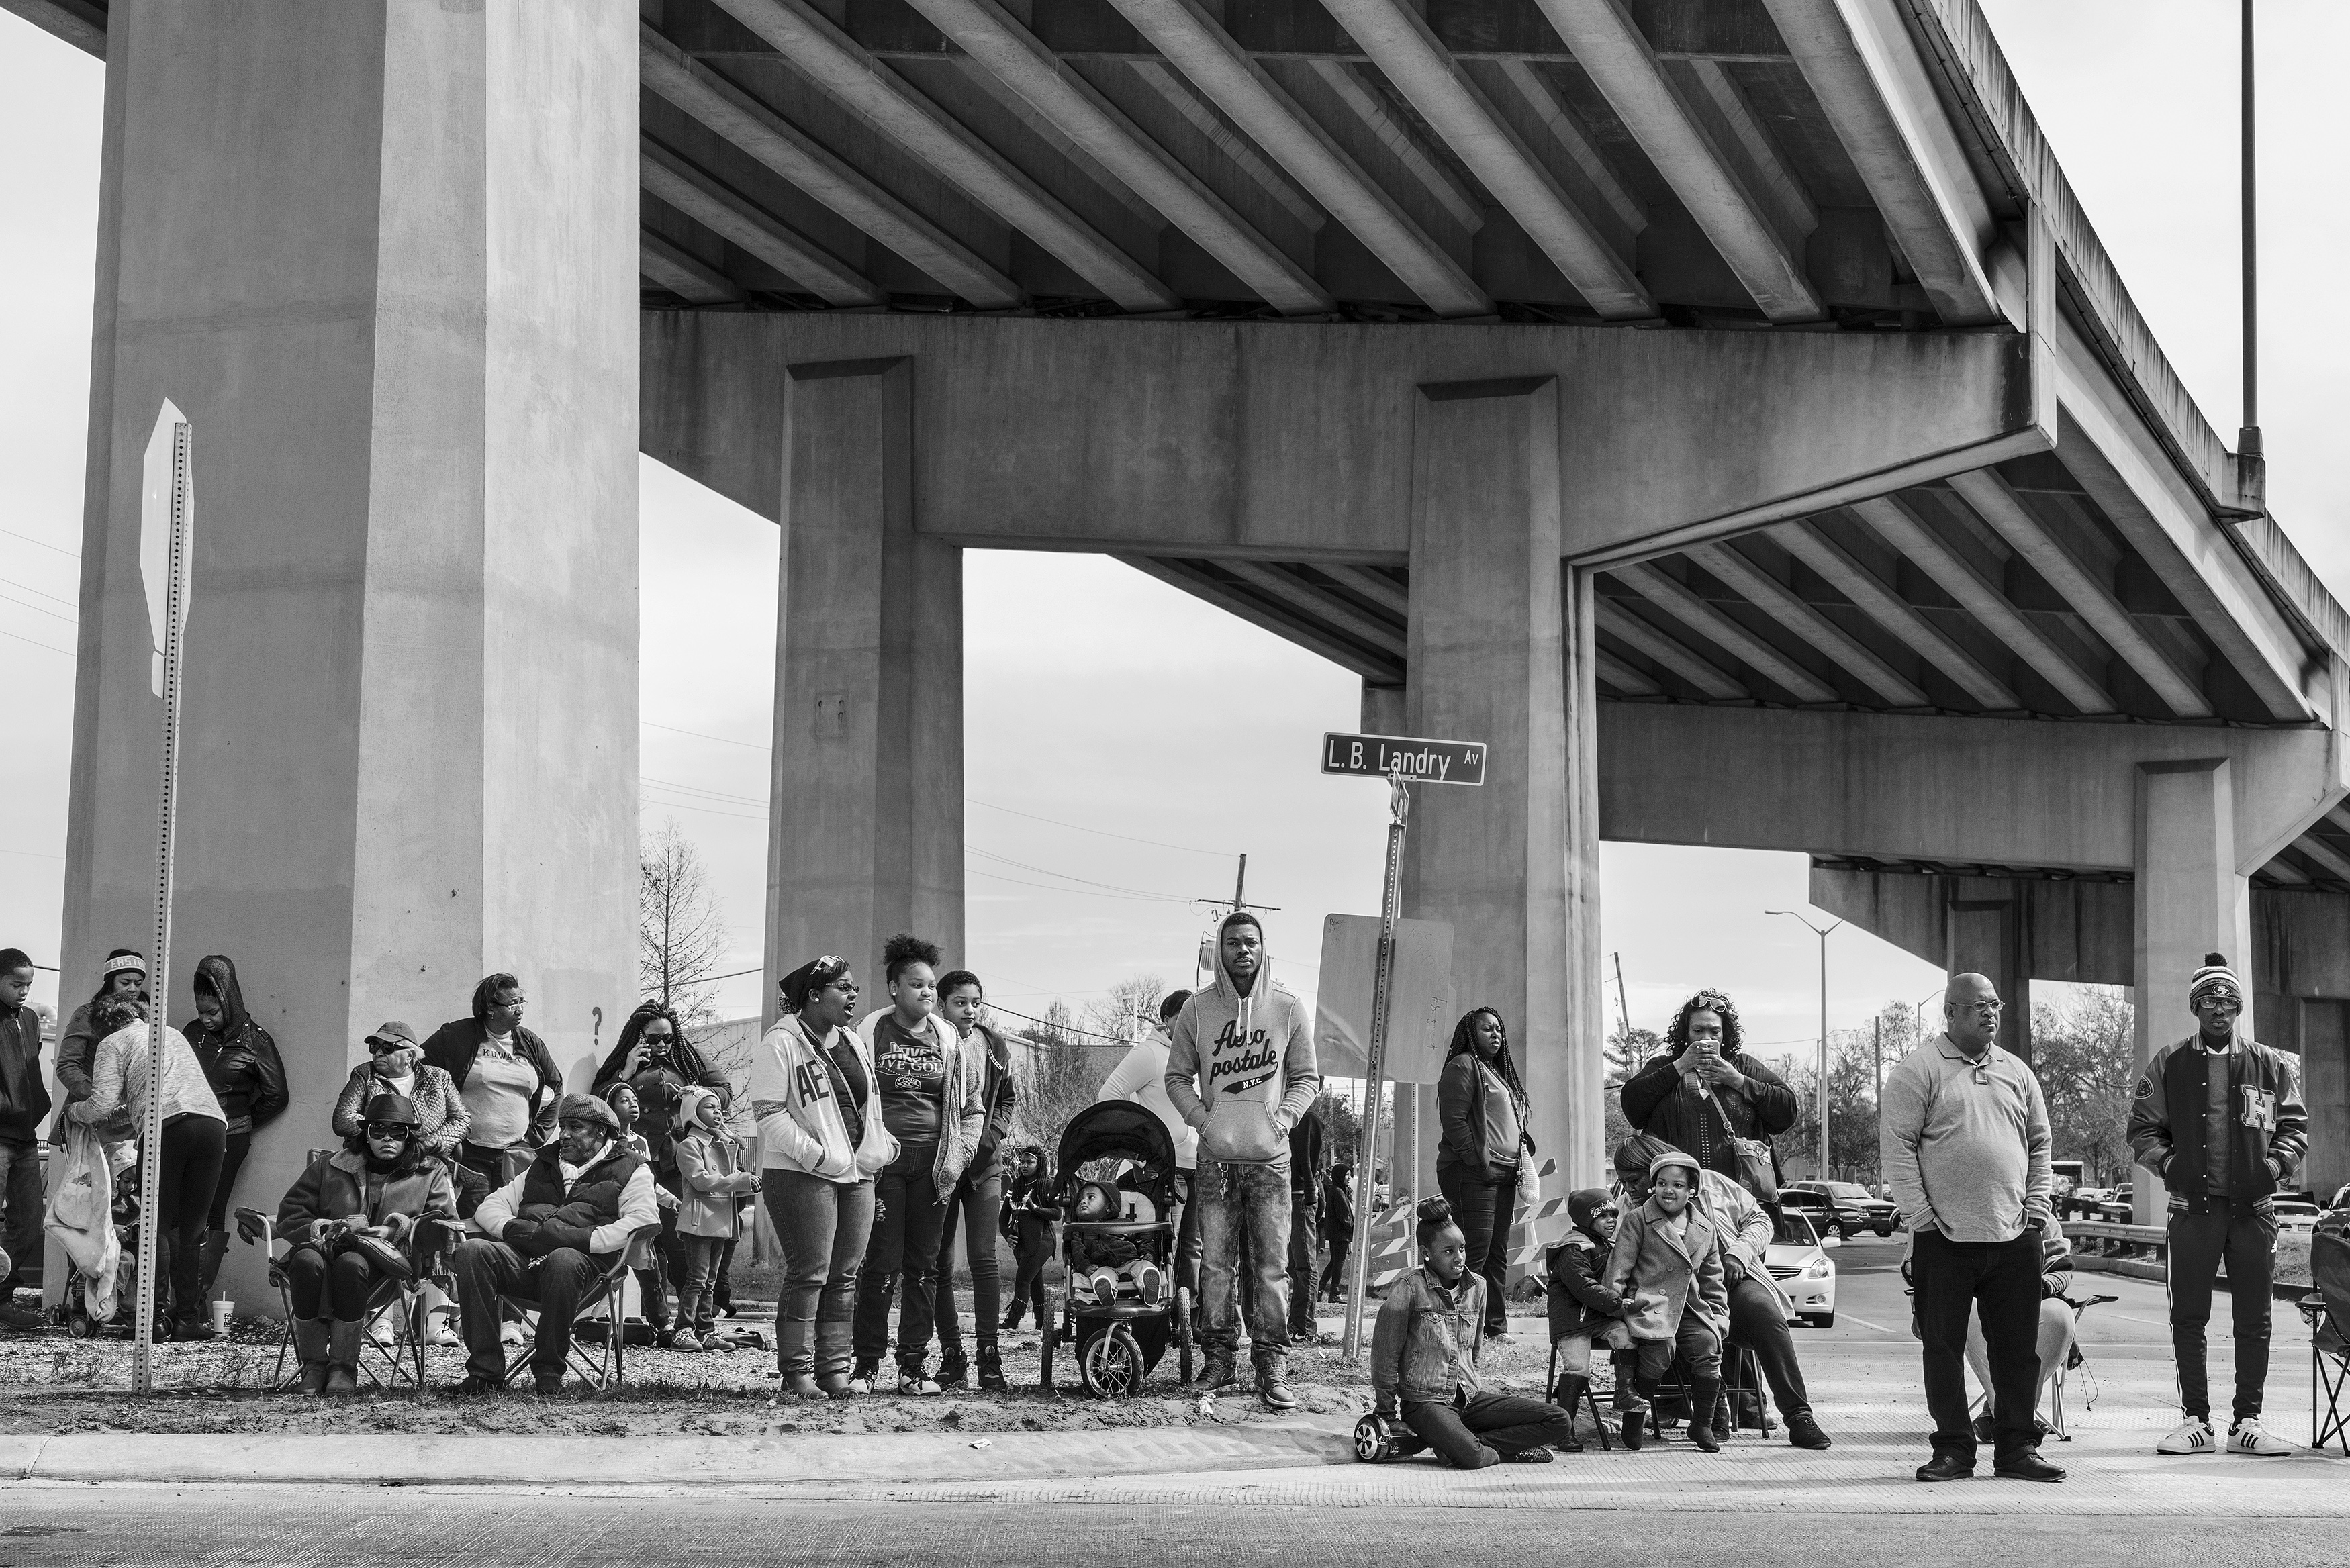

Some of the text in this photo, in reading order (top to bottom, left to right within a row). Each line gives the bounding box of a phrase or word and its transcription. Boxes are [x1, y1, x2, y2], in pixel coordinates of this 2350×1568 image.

[1378, 743, 1451, 781] Landry
[1464, 750, 1478, 765] Av
[483, 1049, 521, 1063] KUWAT
[892, 1044, 931, 1057] LOVE
[1210, 1038, 1276, 1085] postale
[1243, 1078, 1262, 1089] N.Y.C.
[2241, 1084, 2276, 1132] H
